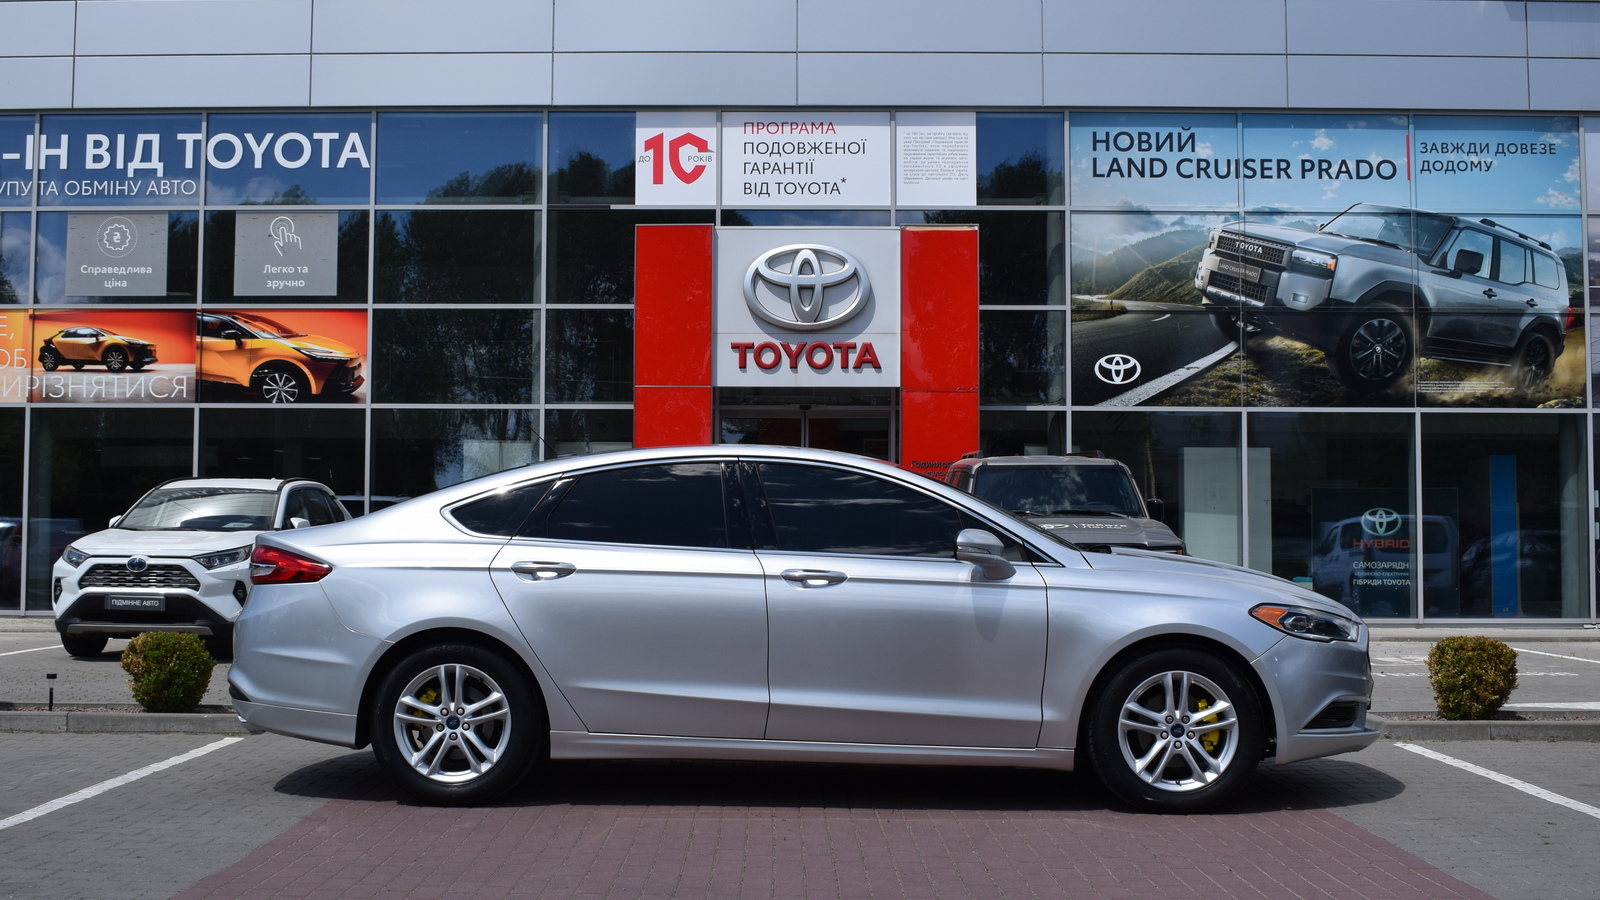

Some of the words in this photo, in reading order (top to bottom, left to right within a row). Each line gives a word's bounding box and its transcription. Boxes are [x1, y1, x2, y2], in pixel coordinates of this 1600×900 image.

[743, 121, 837, 135] ПРОГРАМА
[1092, 126, 1196, 153] НОВИЙ
[85, 133, 164, 178] ВІД
[177, 132, 371, 170] TOYOTA
[743, 138, 868, 158] ПОДОВЖЕНОЇ
[1419, 142, 1491, 156] ЗАВЖДИ
[1494, 142, 1557, 157] ДОВЕЗЕ
[638, 155, 651, 163] ДО
[687, 155, 713, 163] РОКІВ
[743, 158, 816, 175] ГАРАНТІЇ
[1092, 157, 1168, 178] LAND
[1175, 157, 1293, 180] CRUISER
[1300, 158, 1398, 181] PRADO
[1419, 160, 1494, 175] ДОДОМУ
[39, 180, 59, 196] ТА
[64, 180, 142, 196] ОБМІНУ
[146, 179, 197, 196] АВТО
[743, 182, 771, 198] ВІД
[1235, 241, 1262, 253] TOYOTA
[80, 264, 153, 276] Справедлива
[263, 264, 295, 274] Легко
[297, 266, 309, 274] та
[104, 278, 128, 288] ціна
[266, 280, 306, 290] зручно
[730, 341, 882, 370] TOYOTA
[1353, 539, 1410, 549] HYBRID
[1353, 561, 1410, 570] САМОЗАРЯДН
